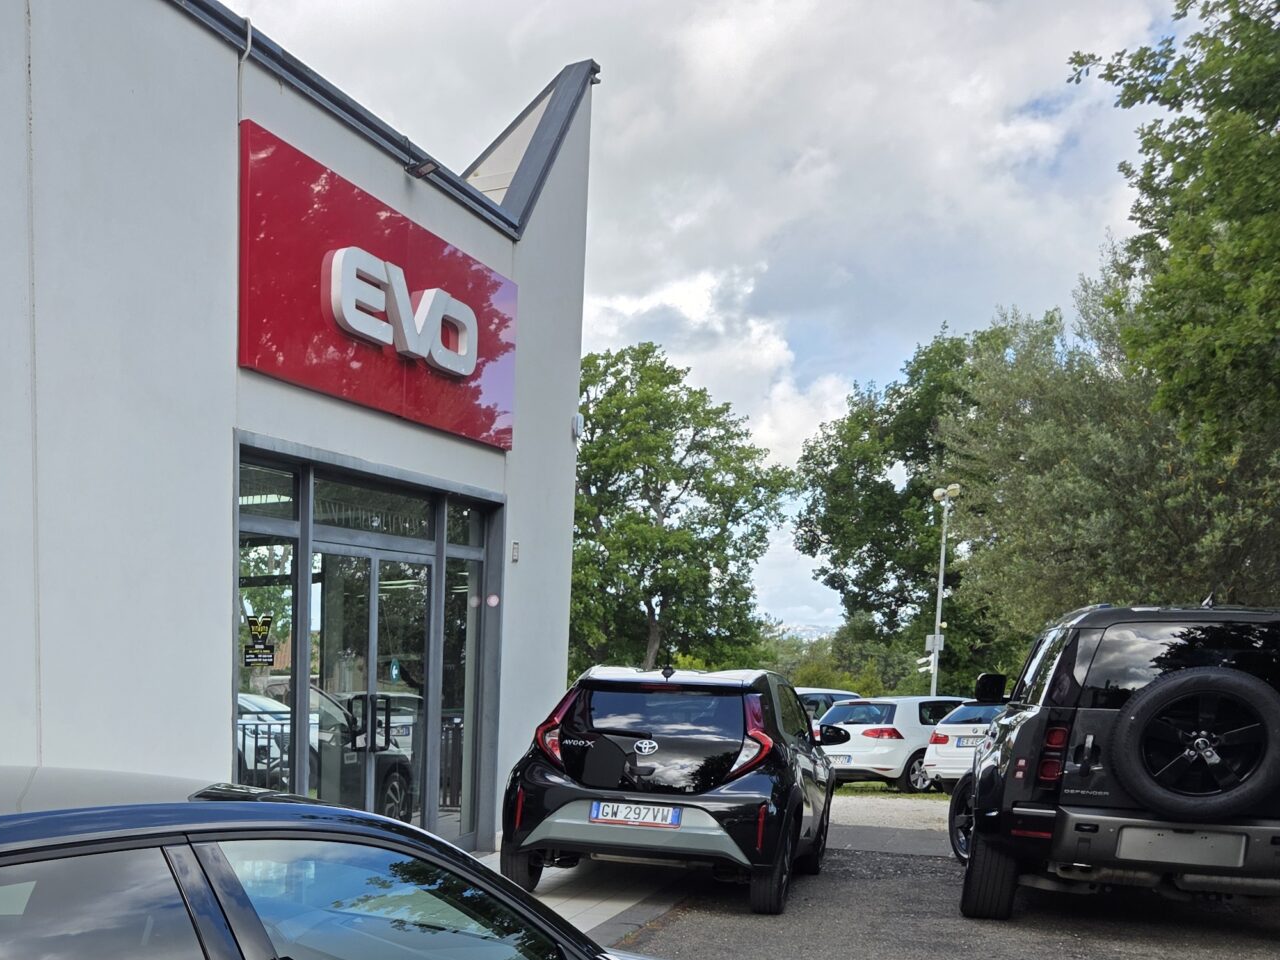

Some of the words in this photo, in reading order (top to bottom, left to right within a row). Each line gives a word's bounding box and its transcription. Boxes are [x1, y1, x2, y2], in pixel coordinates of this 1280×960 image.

[330, 246, 479, 377] EVO
[584, 740, 596, 748] X
[601, 803, 620, 819] GW
[623, 805, 671, 823] 297VW
